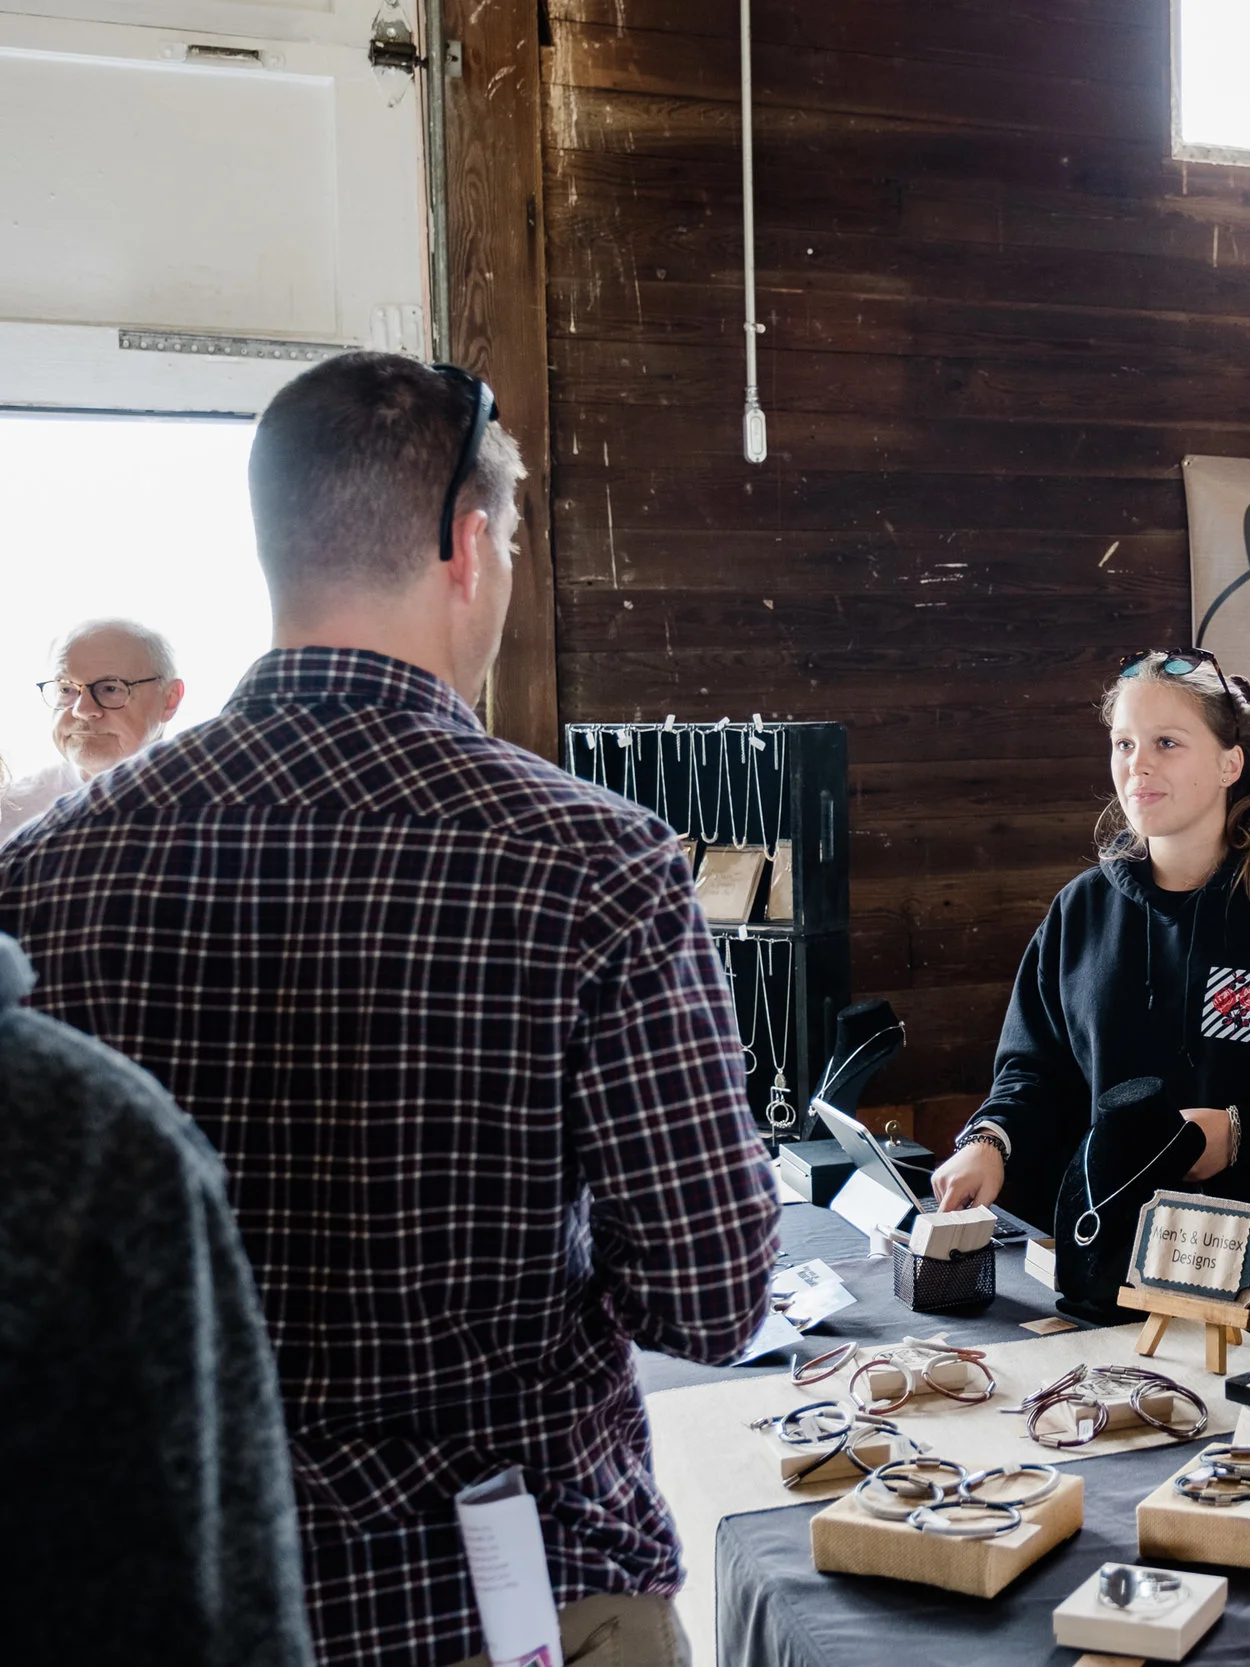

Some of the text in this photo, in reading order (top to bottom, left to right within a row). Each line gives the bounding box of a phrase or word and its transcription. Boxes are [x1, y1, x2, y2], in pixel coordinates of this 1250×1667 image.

[1152, 1225, 1244, 1252] Men's & Unisex
[1171, 1248, 1217, 1271] Designs
